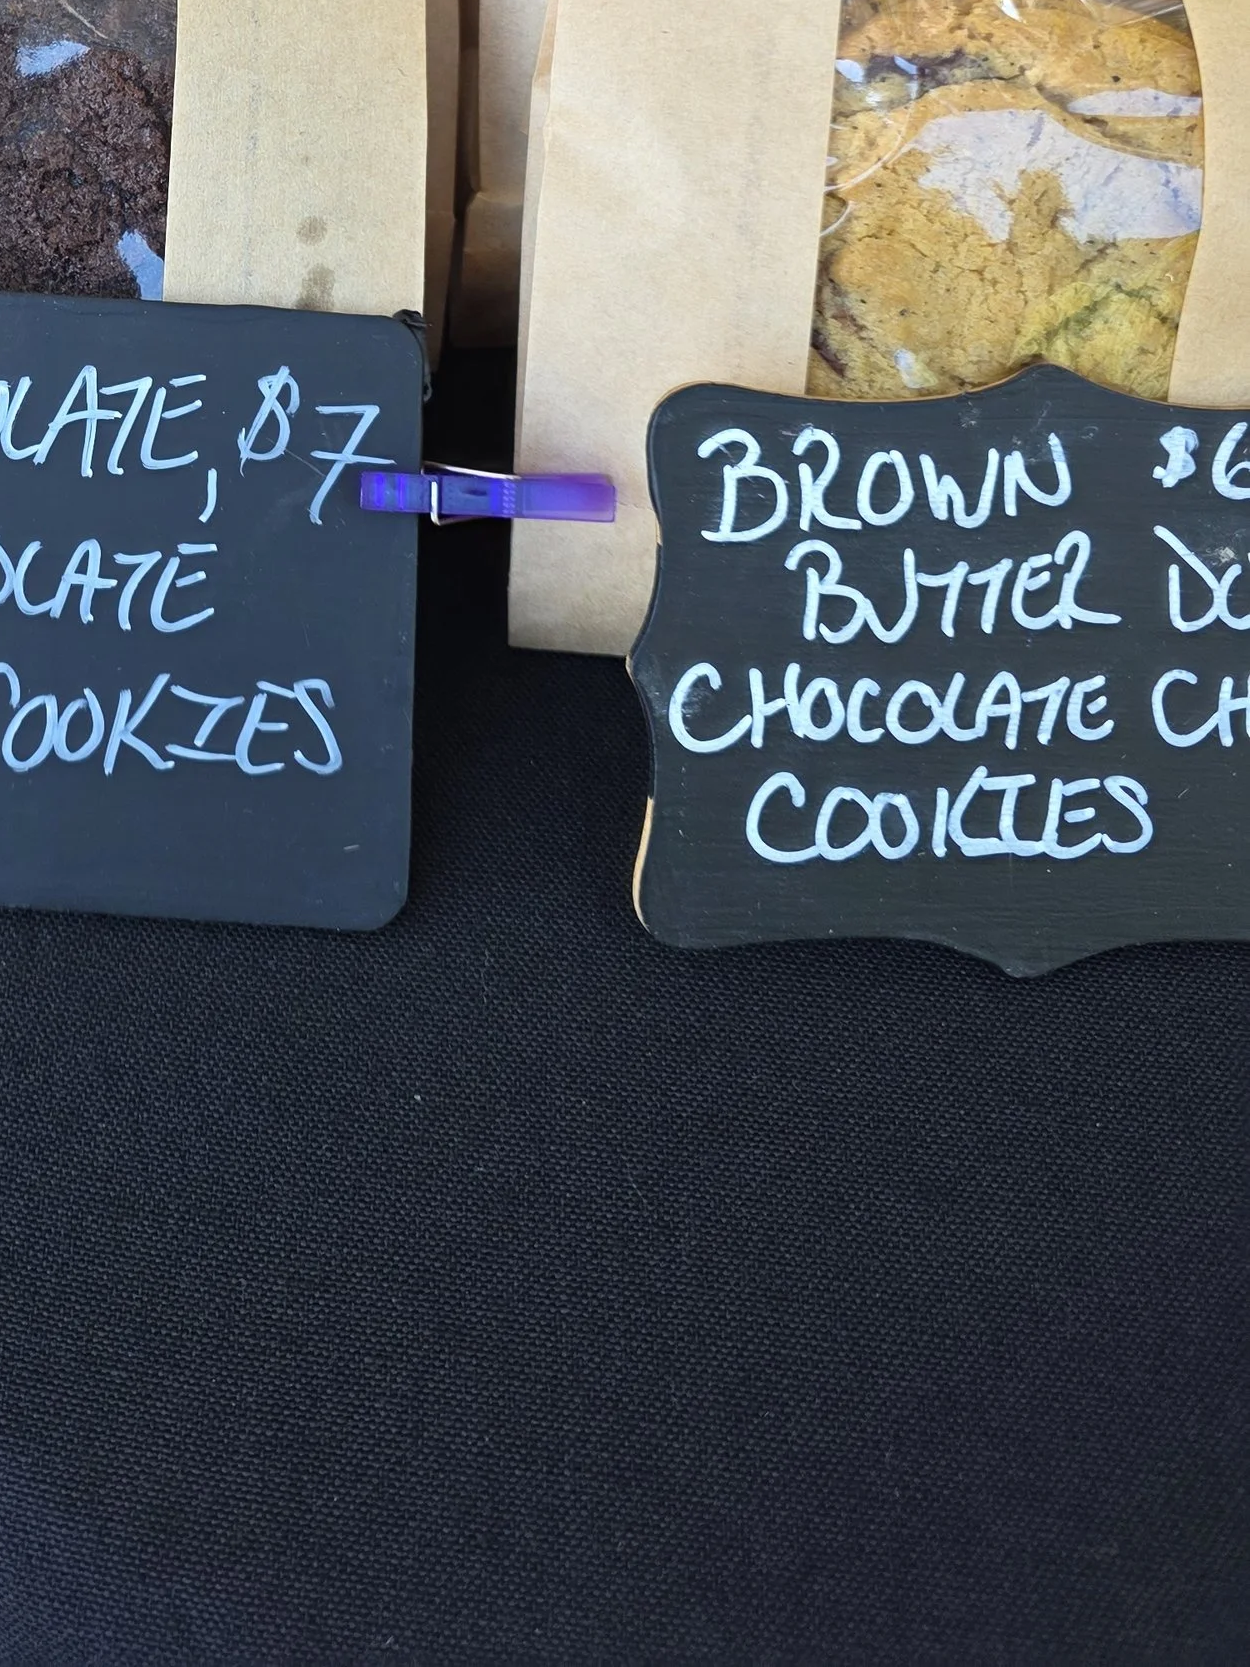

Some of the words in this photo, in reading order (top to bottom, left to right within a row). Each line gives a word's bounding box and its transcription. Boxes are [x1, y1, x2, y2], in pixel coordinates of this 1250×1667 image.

[238, 365, 397, 525] $7
[696, 427, 1073, 543] BROWN
[785, 530, 1123, 644] BUTTER
[667, 662, 1115, 754] CHOCOLATE
[745, 766, 1154, 864] COOKIES
